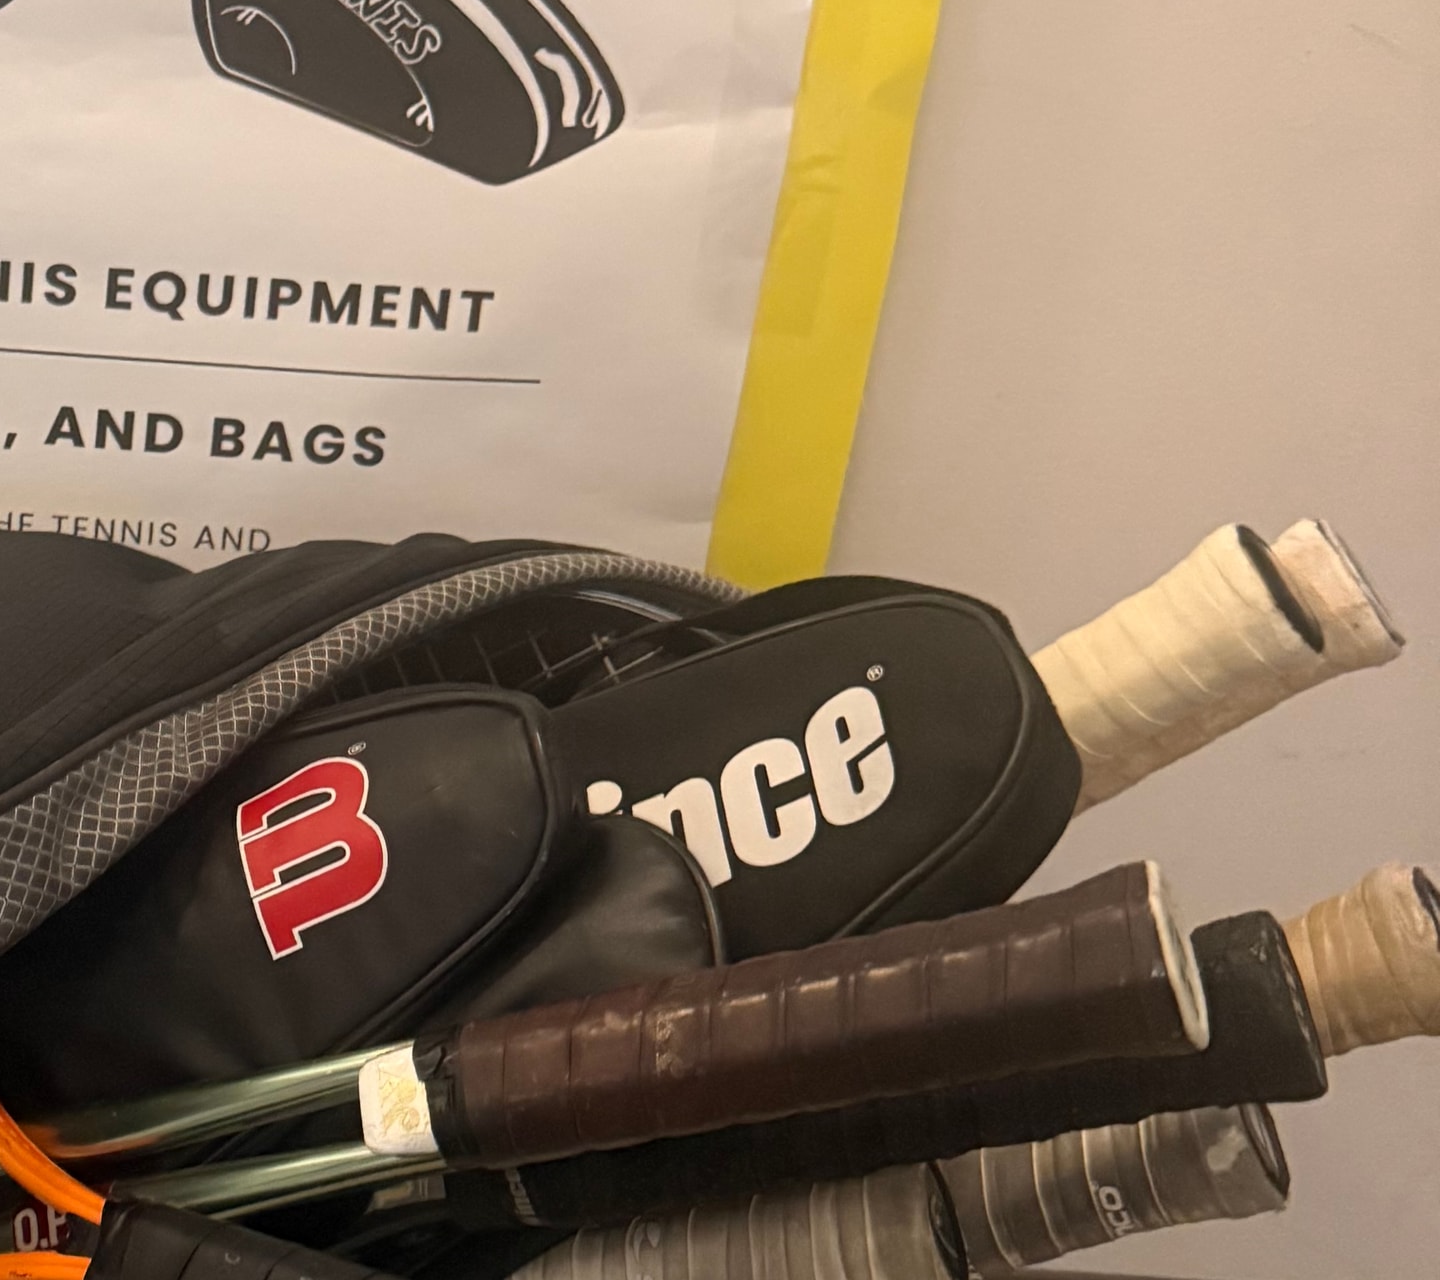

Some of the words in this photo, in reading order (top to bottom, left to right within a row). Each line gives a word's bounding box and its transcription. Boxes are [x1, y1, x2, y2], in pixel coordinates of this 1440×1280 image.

[104, 266, 496, 334] EQUIPMENT
[44, 405, 185, 454] AND
[209, 416, 388, 467] BAGS
[50, 513, 179, 548] TENNIS
[193, 525, 272, 553] AND
